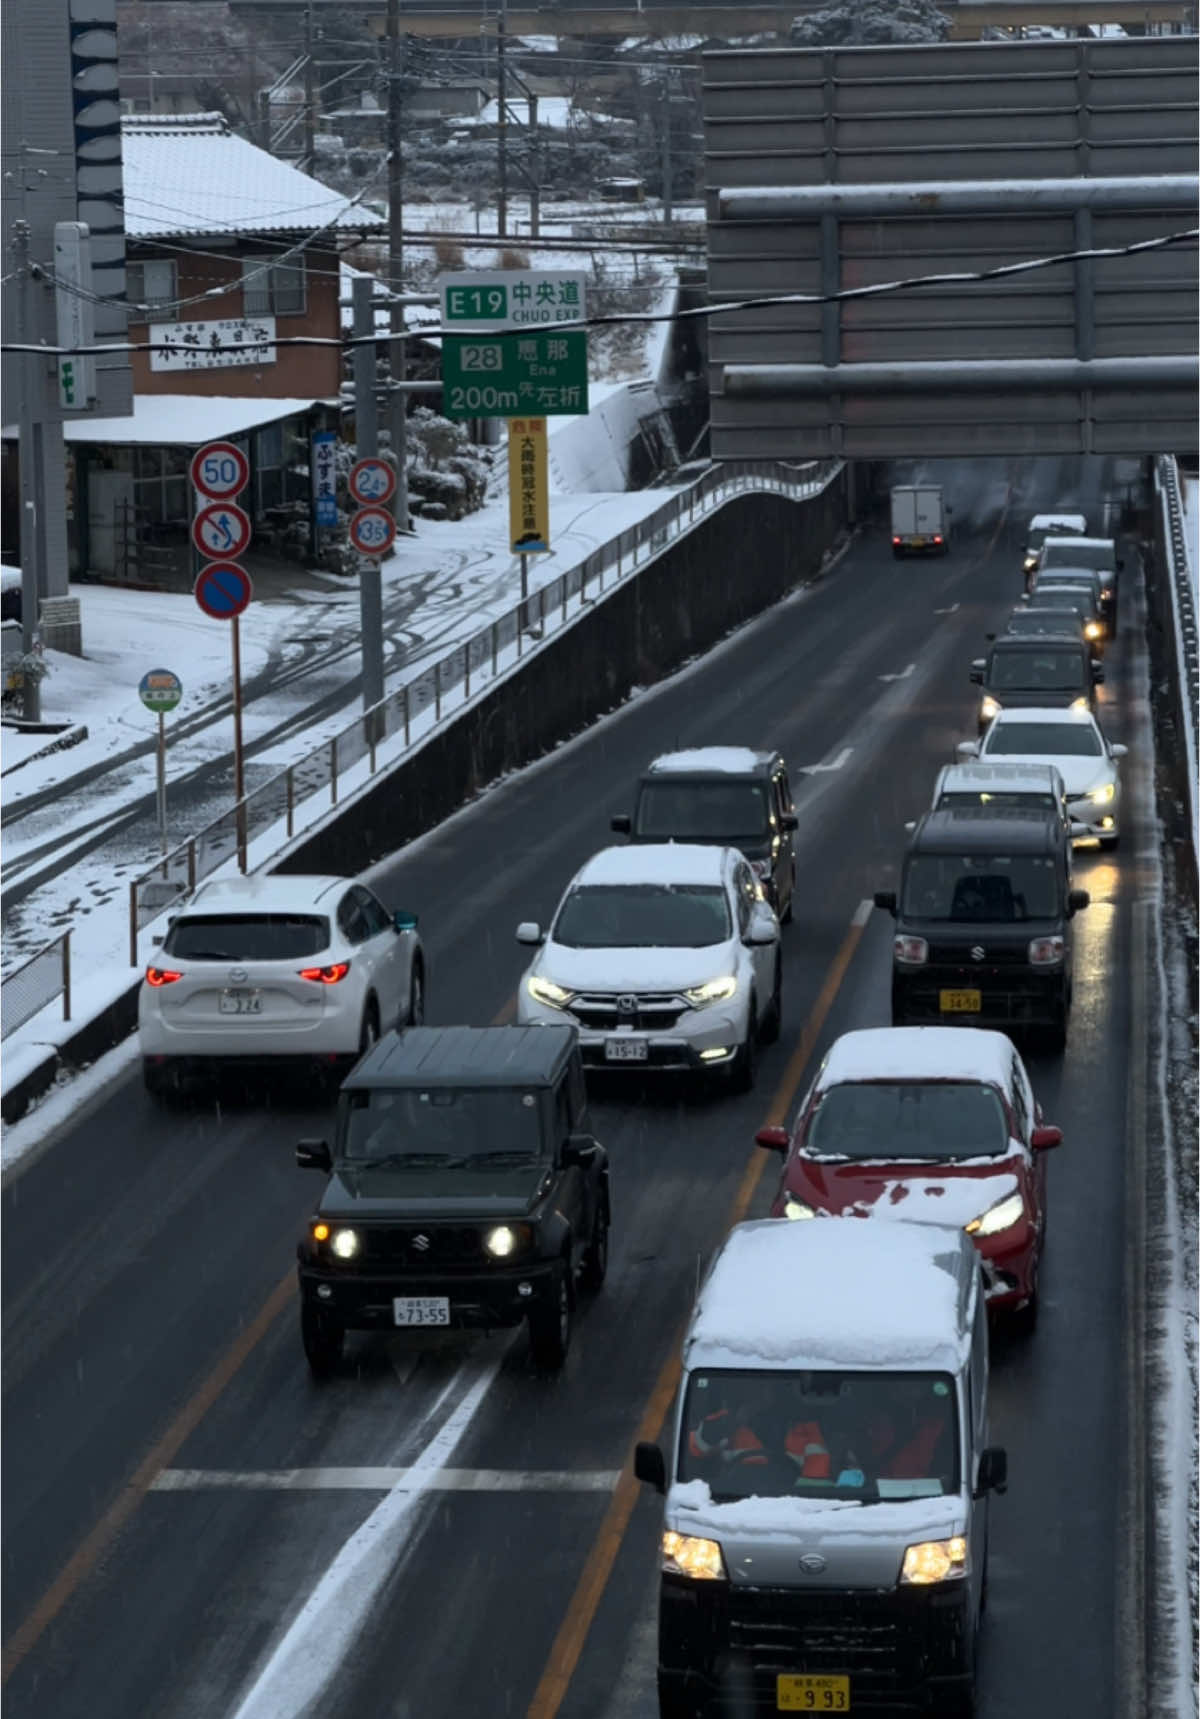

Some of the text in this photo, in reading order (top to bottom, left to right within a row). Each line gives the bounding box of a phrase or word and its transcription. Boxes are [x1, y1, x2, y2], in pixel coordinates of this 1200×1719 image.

[450, 291, 503, 315] E19
[512, 280, 580, 306] 中央道
[465, 346, 498, 369] 28
[517, 339, 568, 361] 恵那
[529, 364, 556, 377] Ena
[204, 458, 236, 485] 50
[317, 444, 335, 499] ふすま
